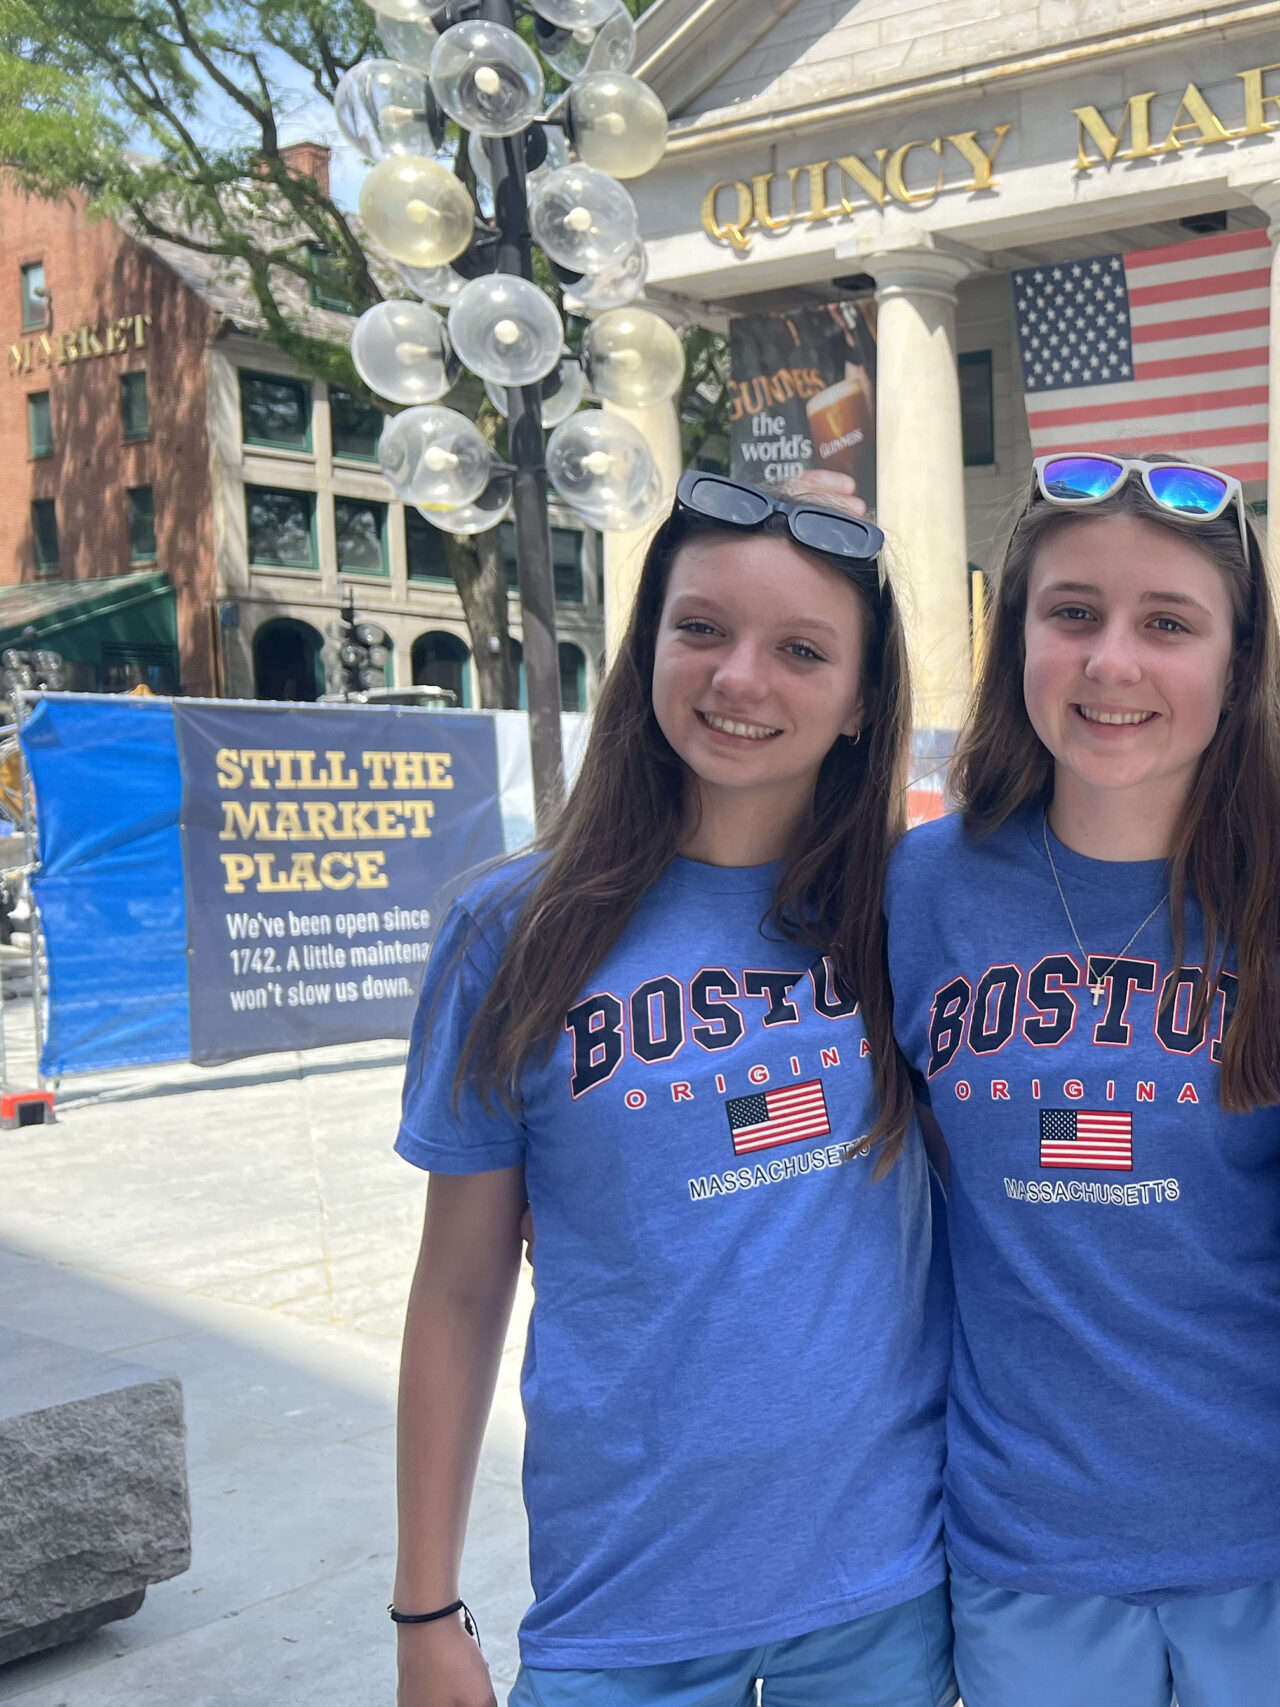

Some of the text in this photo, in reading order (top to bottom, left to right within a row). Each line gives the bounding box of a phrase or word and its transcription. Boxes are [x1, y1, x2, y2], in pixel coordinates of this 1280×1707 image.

[702, 124, 1012, 250] QUINCY
[8, 314, 153, 376] MARKET
[752, 412, 786, 437] the
[741, 434, 813, 462] world's
[216, 748, 455, 790] STILL THE
[219, 799, 435, 841] MARKET
[219, 850, 389, 894] PLACE
[226, 906, 431, 940] We've been open since
[230, 947, 282, 975] 1742.
[286, 946, 300, 972] A
[303, 943, 346, 970] little
[230, 974, 415, 1011] won't slow us down.
[1004, 1177, 1180, 1206] MASSACHUSETTS
